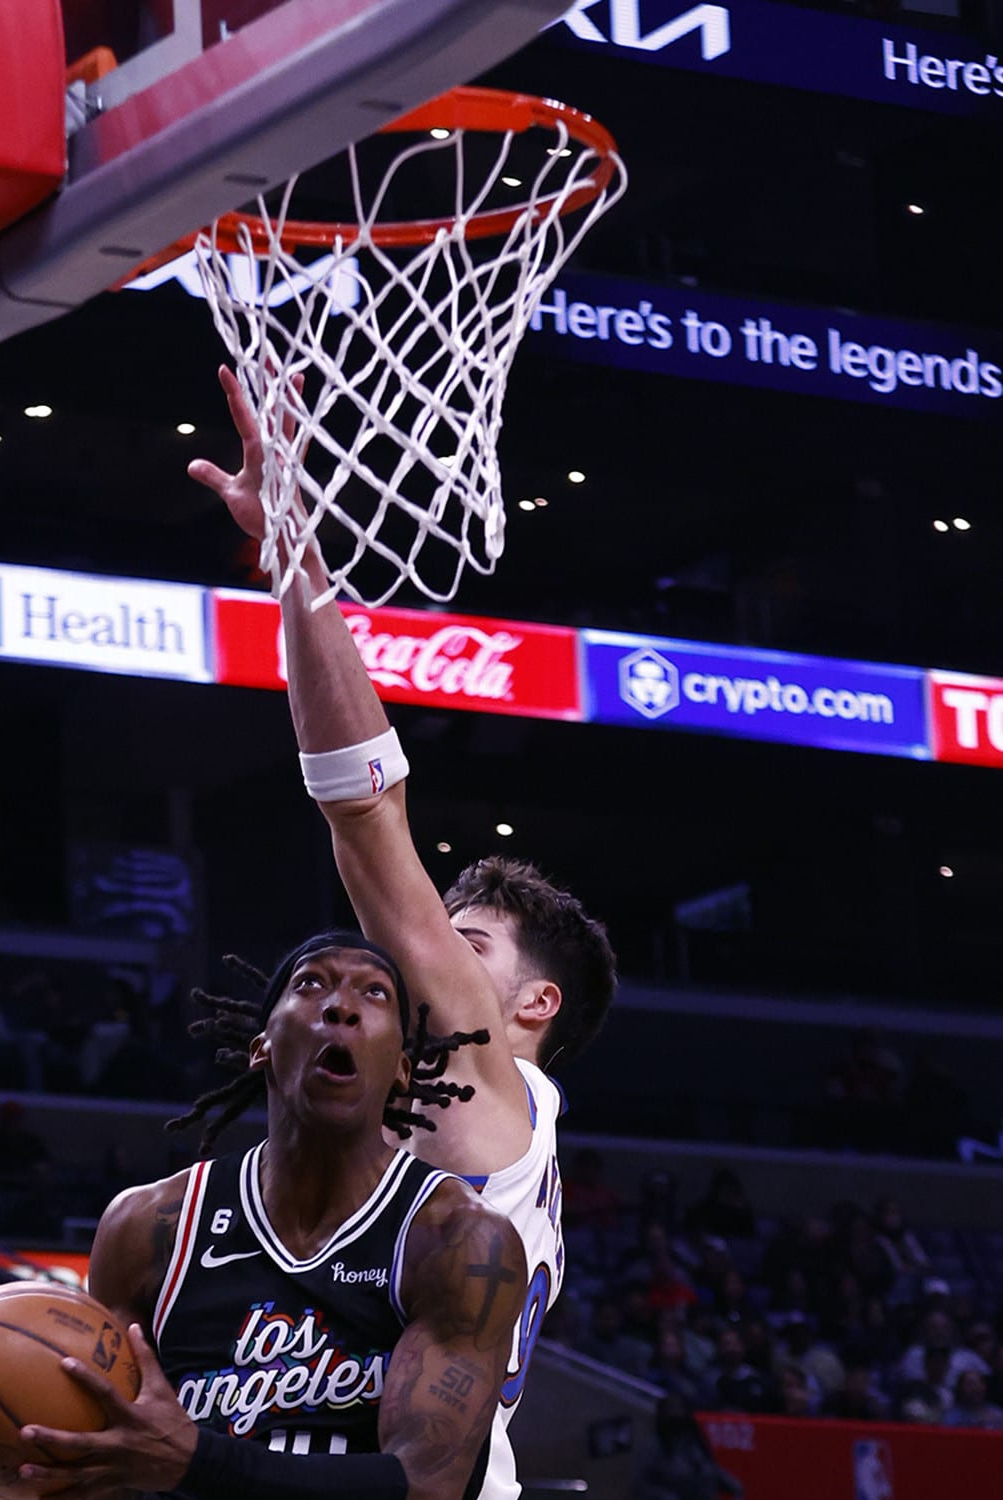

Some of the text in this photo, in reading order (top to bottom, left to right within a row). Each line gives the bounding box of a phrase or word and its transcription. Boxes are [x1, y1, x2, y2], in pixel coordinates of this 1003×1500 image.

[529, 288, 1002, 399] Here's to the legends
[19, 591, 186, 655] Health
[682, 672, 894, 724] crypto.com
[210, 1208, 233, 1234] 6
[331, 1261, 388, 1288] honey
[233, 1308, 328, 1367] los
[178, 1348, 384, 1436] angeles
